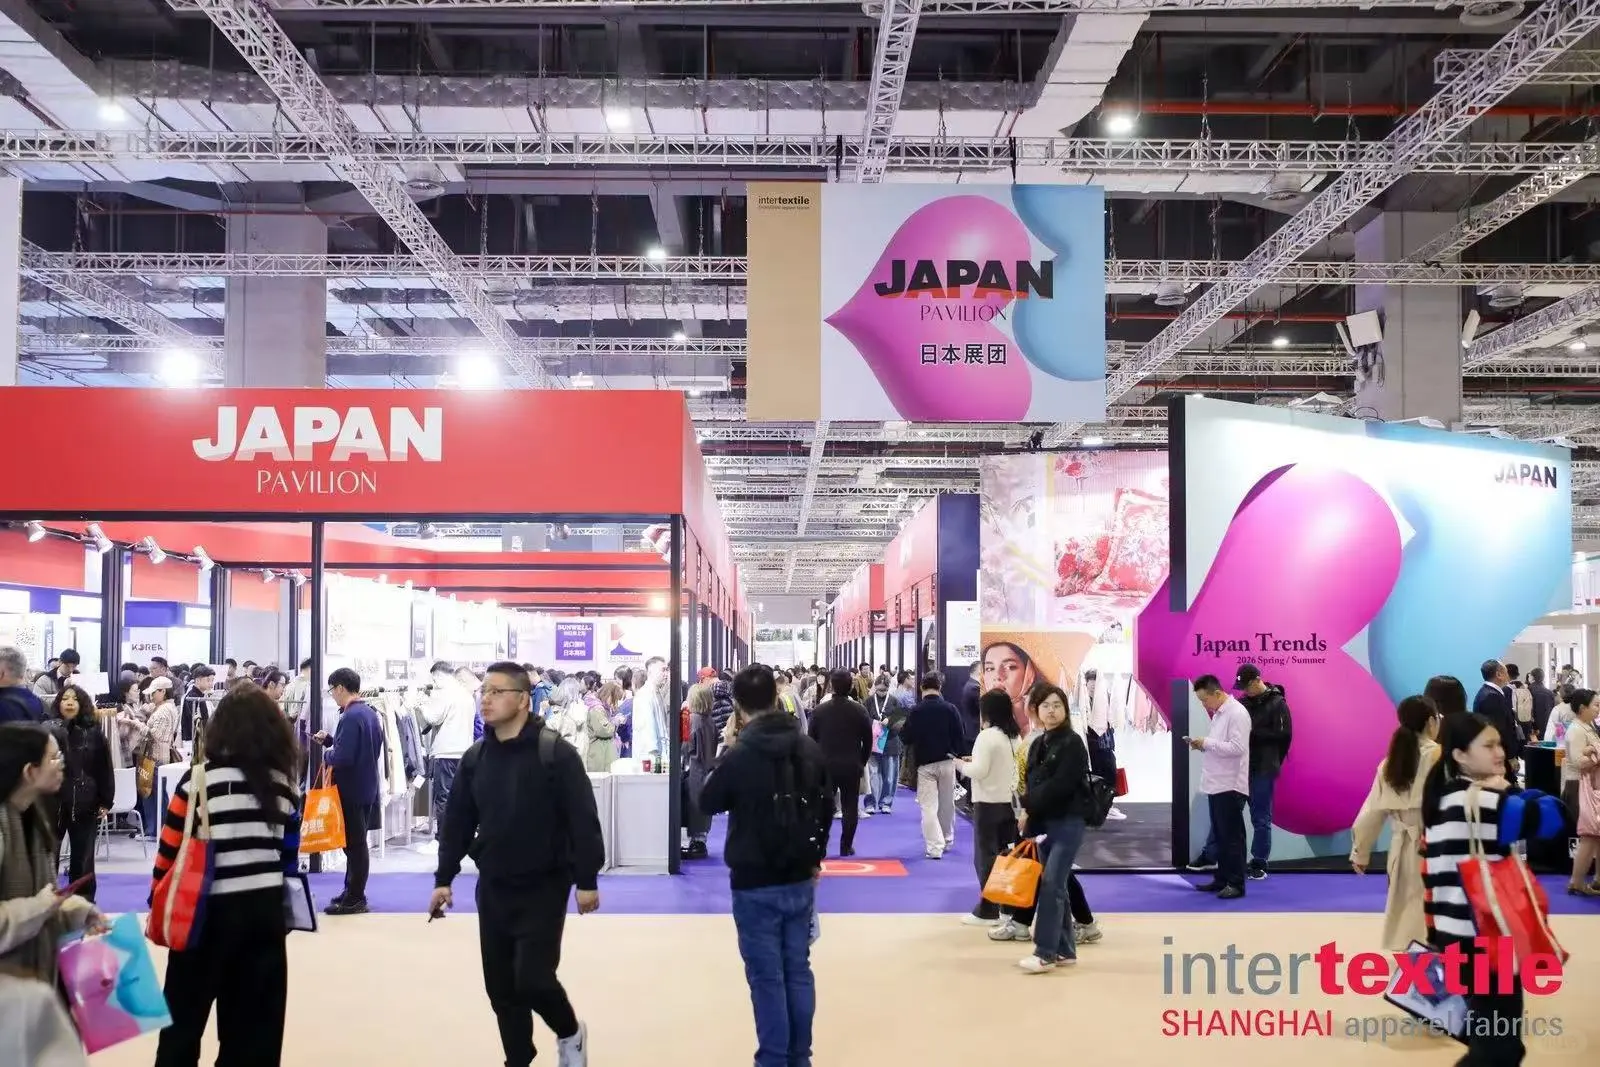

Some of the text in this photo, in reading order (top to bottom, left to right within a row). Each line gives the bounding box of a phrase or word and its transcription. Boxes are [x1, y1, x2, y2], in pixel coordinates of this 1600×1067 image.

[758, 196, 810, 205] intertextile
[874, 259, 1054, 299] JAPAN
[920, 305, 1008, 322] PAVILION
[920, 343, 1008, 366] 日本展团
[192, 406, 443, 462] JAPAN
[257, 470, 377, 494] PAVILION
[1494, 463, 1558, 489] JAPAN
[1192, 633, 1327, 658] Japan Trends
[1236, 656, 1256, 664] 2026
[1257, 655, 1285, 666] Spring
[1291, 656, 1326, 664] Summer
